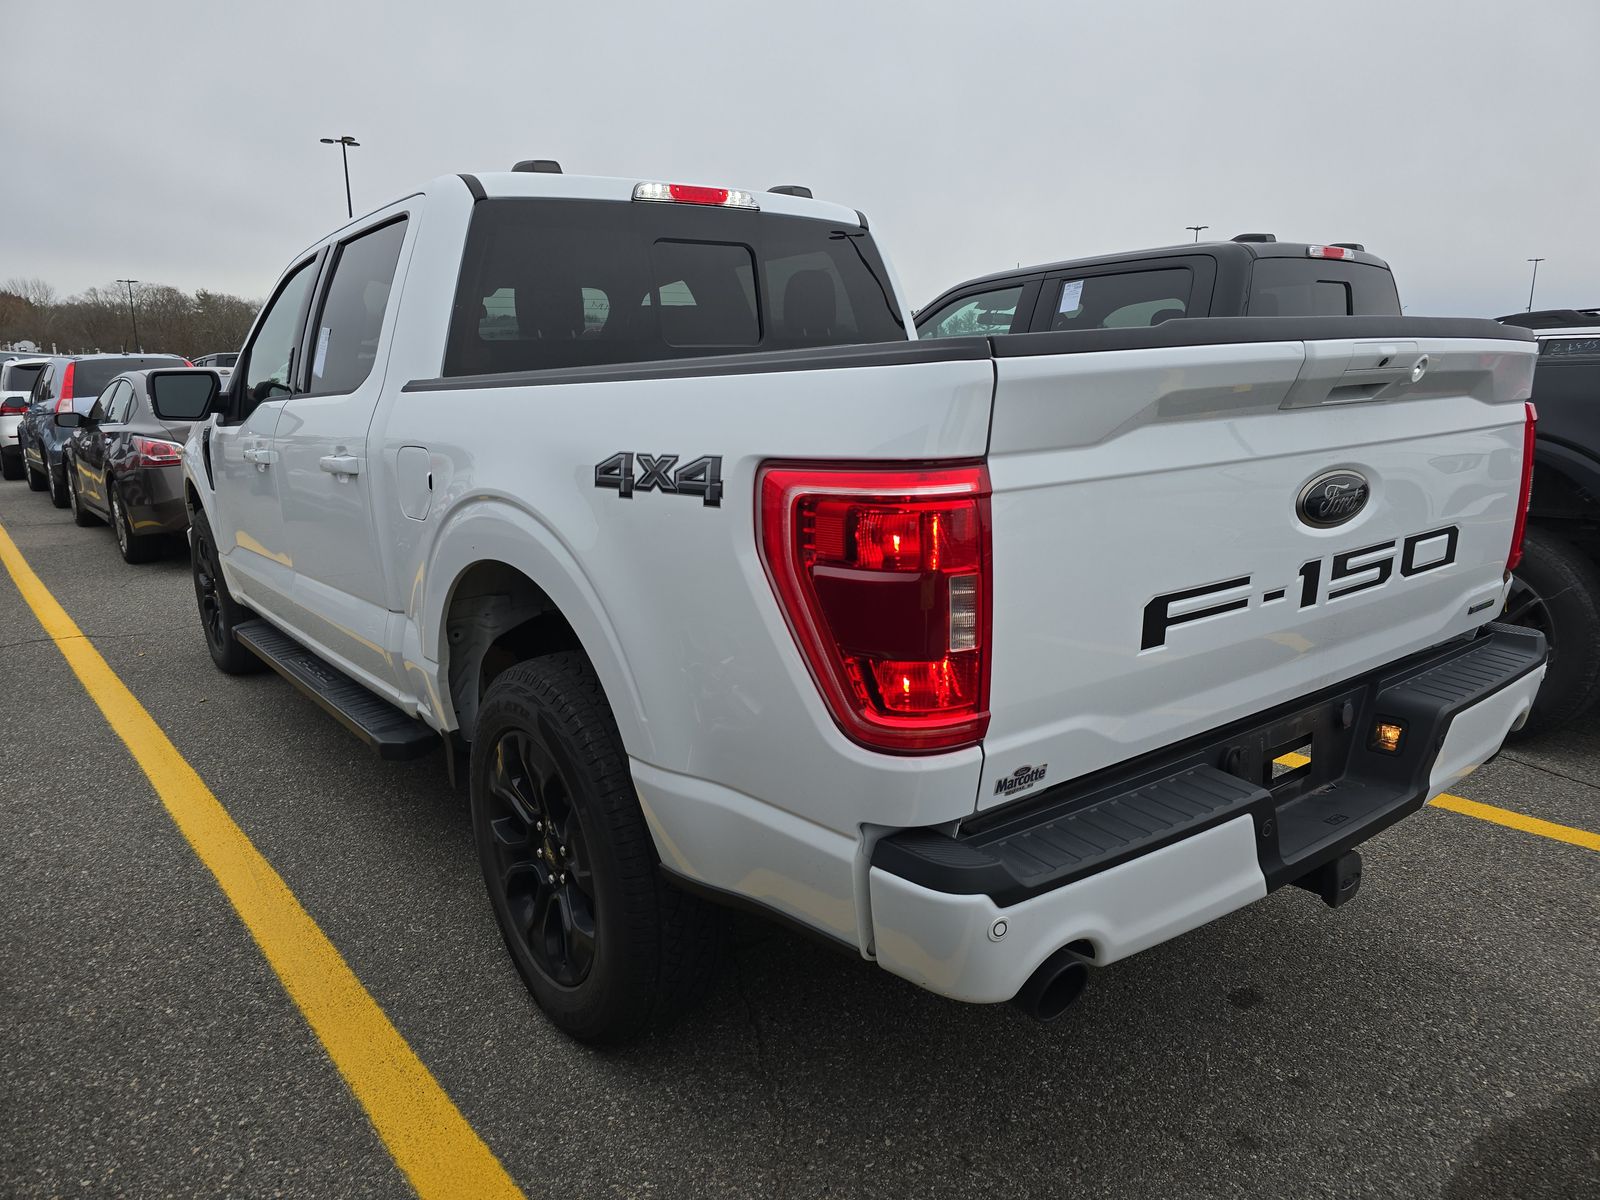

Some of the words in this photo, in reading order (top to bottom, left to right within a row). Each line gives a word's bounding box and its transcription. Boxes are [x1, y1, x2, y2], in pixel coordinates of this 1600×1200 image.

[1320, 483, 1364, 515] Ford
[1139, 524, 1460, 652] F-150
[995, 767, 1046, 794] Marcotte
